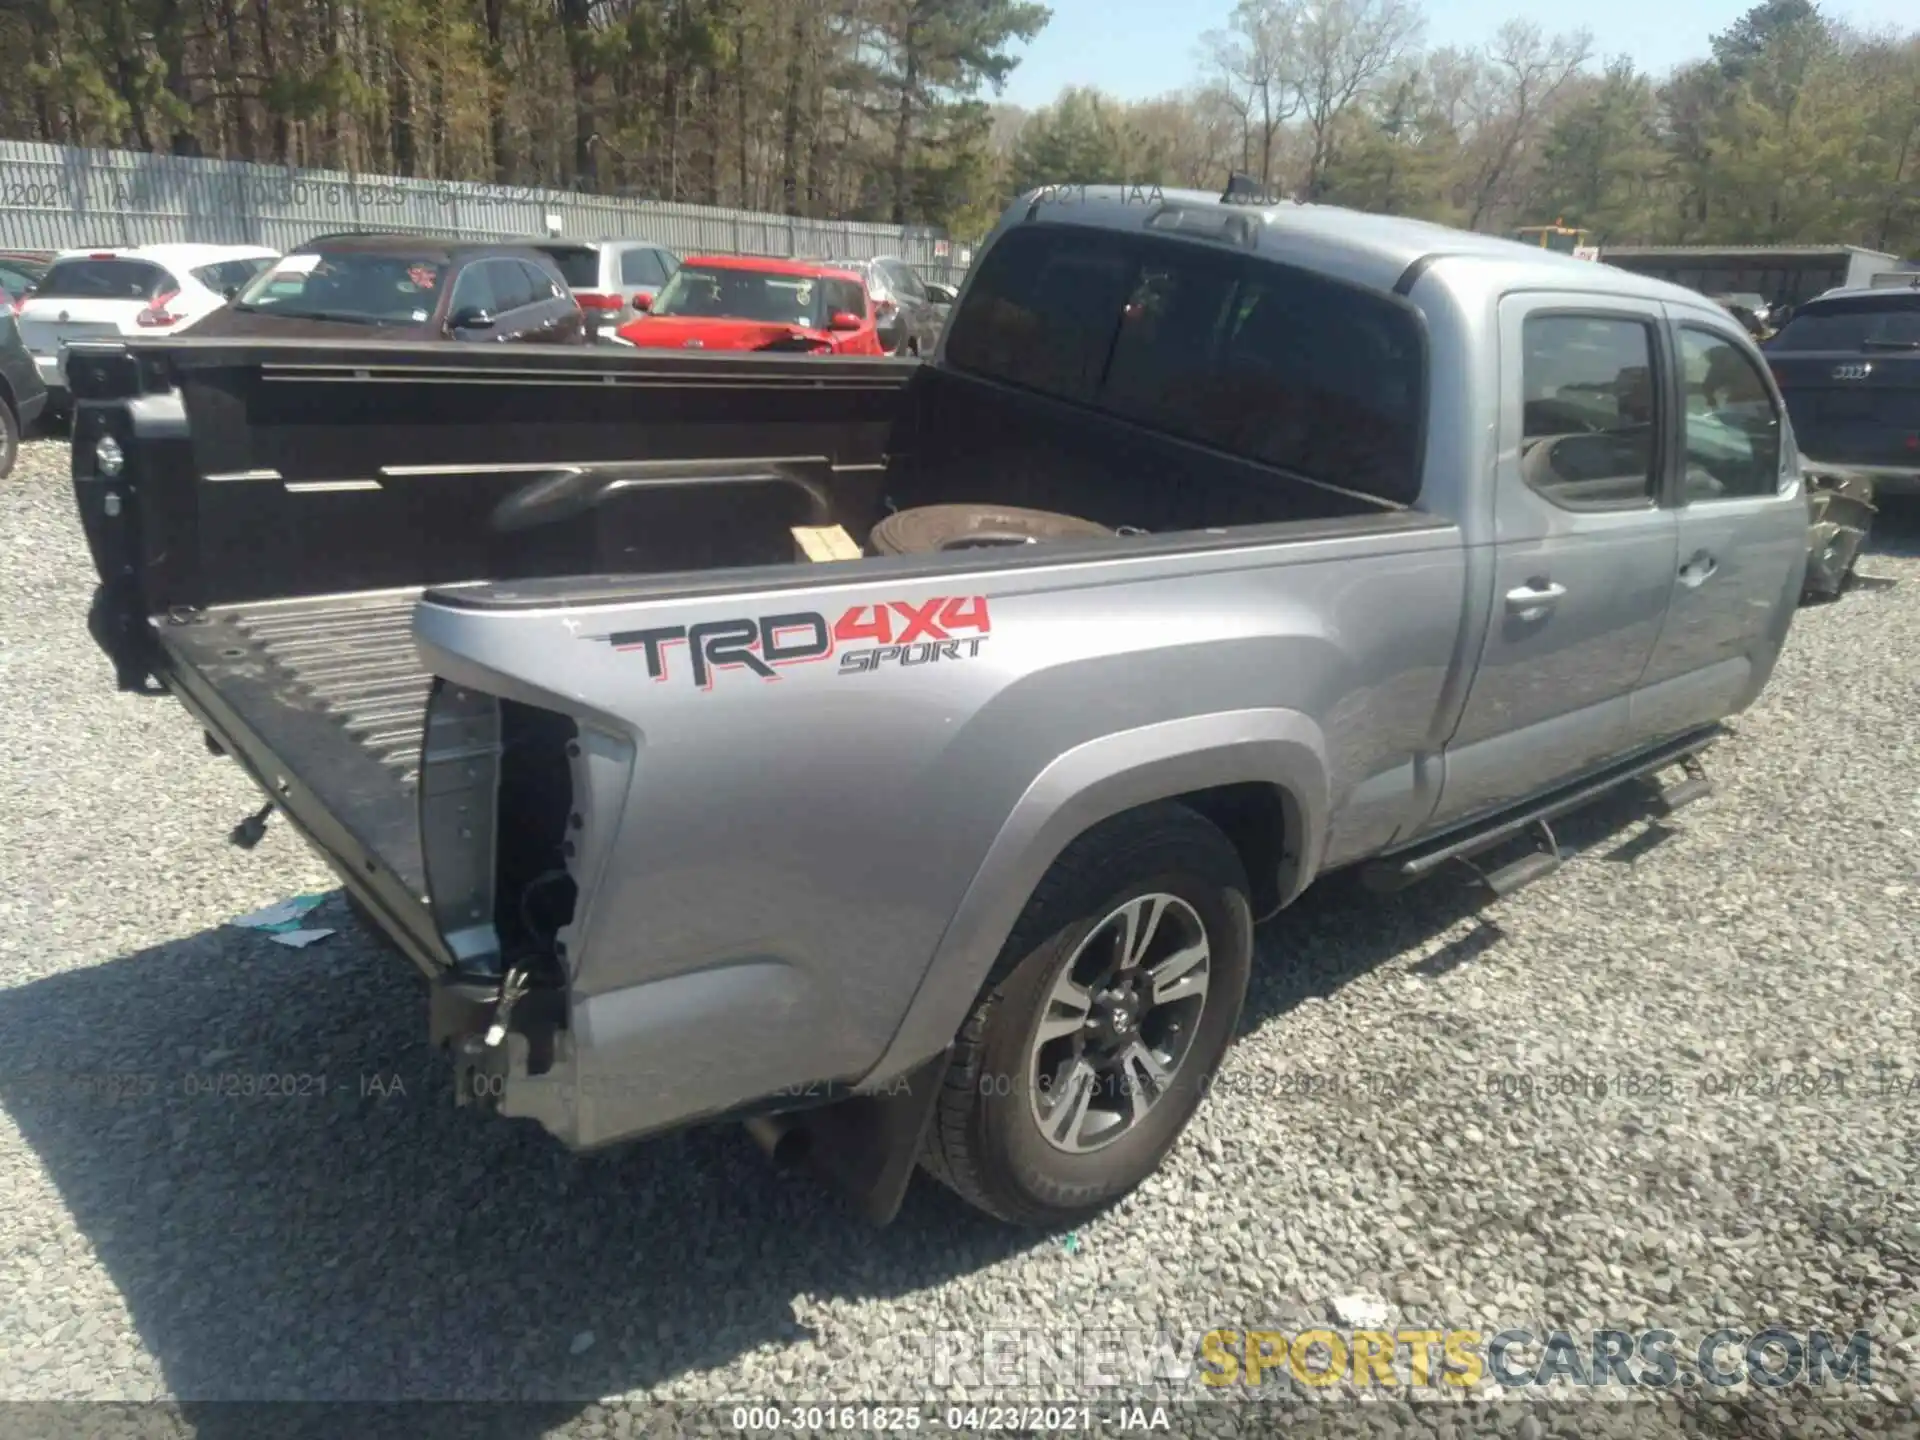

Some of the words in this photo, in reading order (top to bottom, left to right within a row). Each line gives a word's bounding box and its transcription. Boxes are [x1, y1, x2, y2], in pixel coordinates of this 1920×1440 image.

[610, 611, 833, 692] TRD
[834, 595, 990, 645] 4X4
[838, 635, 989, 675] SPORT
